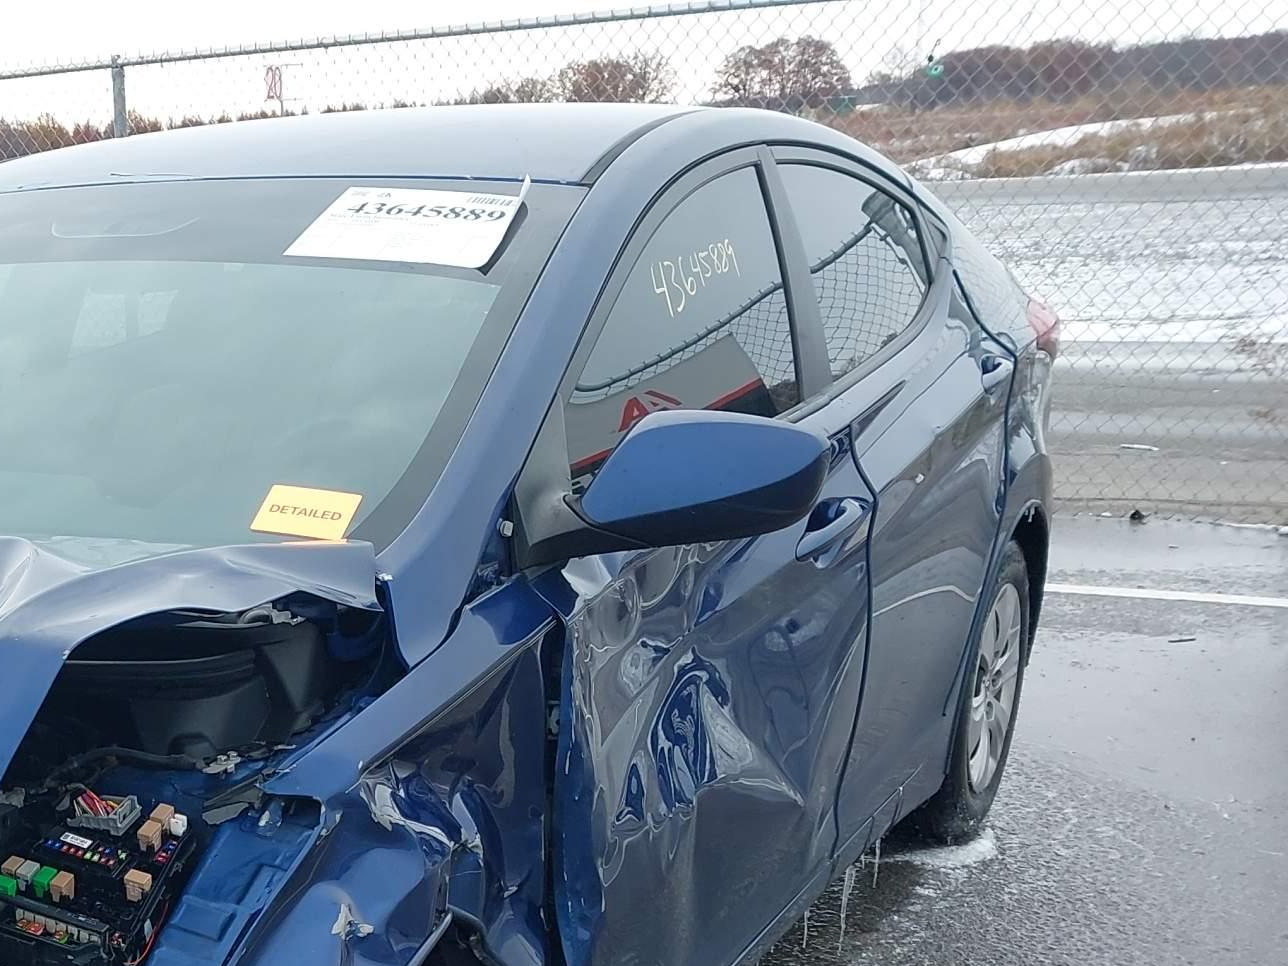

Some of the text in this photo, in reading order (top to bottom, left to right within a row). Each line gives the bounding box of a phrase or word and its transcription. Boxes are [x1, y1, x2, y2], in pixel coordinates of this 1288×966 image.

[346, 201, 507, 222] 43645889
[651, 239, 740, 318] 43645889
[269, 504, 342, 521] DETAILED
